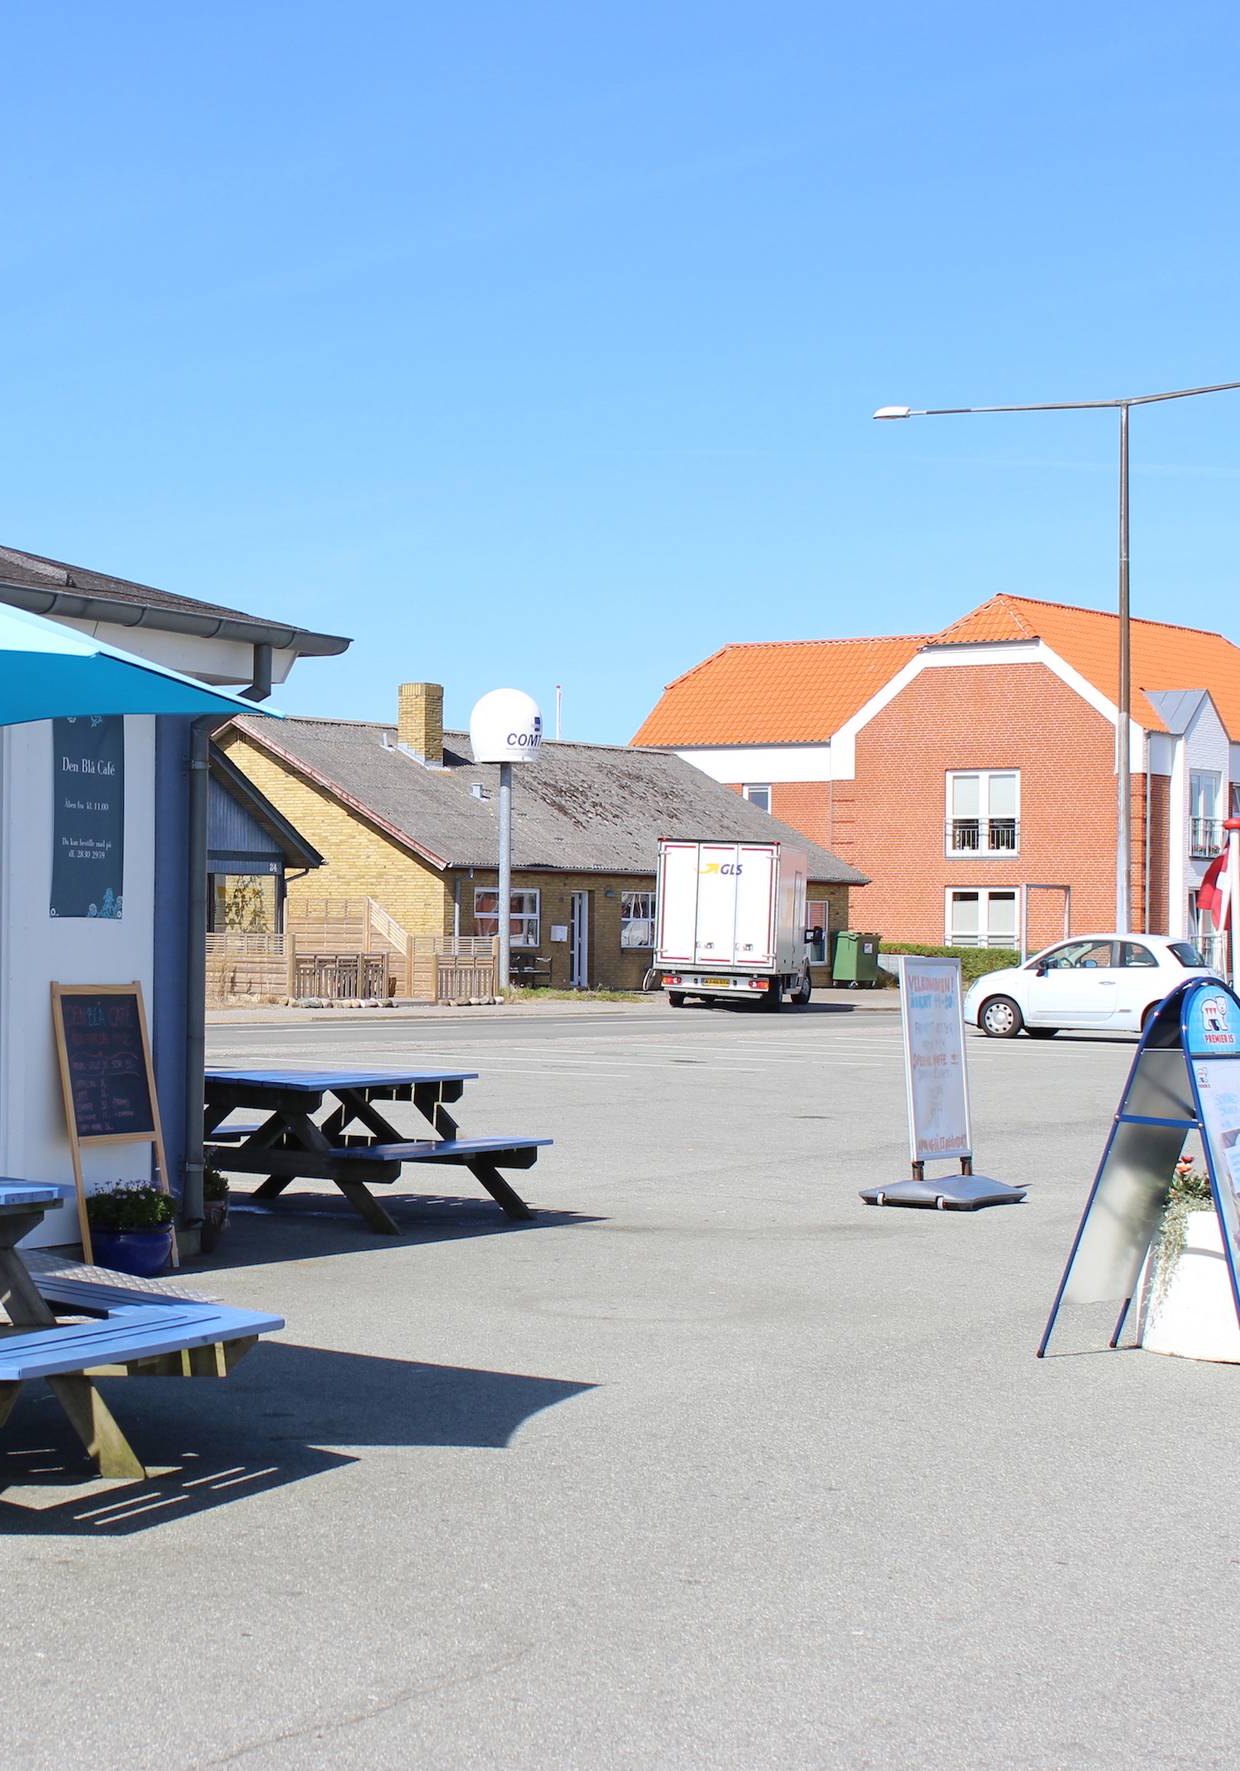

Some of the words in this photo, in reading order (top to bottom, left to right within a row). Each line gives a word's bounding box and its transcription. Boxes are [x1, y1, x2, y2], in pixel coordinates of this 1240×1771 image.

[62, 756, 79, 773] Den
[81, 758, 95, 774] Blå
[97, 760, 115, 776] Café
[720, 863, 743, 876] GLS
[1205, 1034, 1228, 1043] PREMIER
[1229, 1034, 1234, 1043] IS
